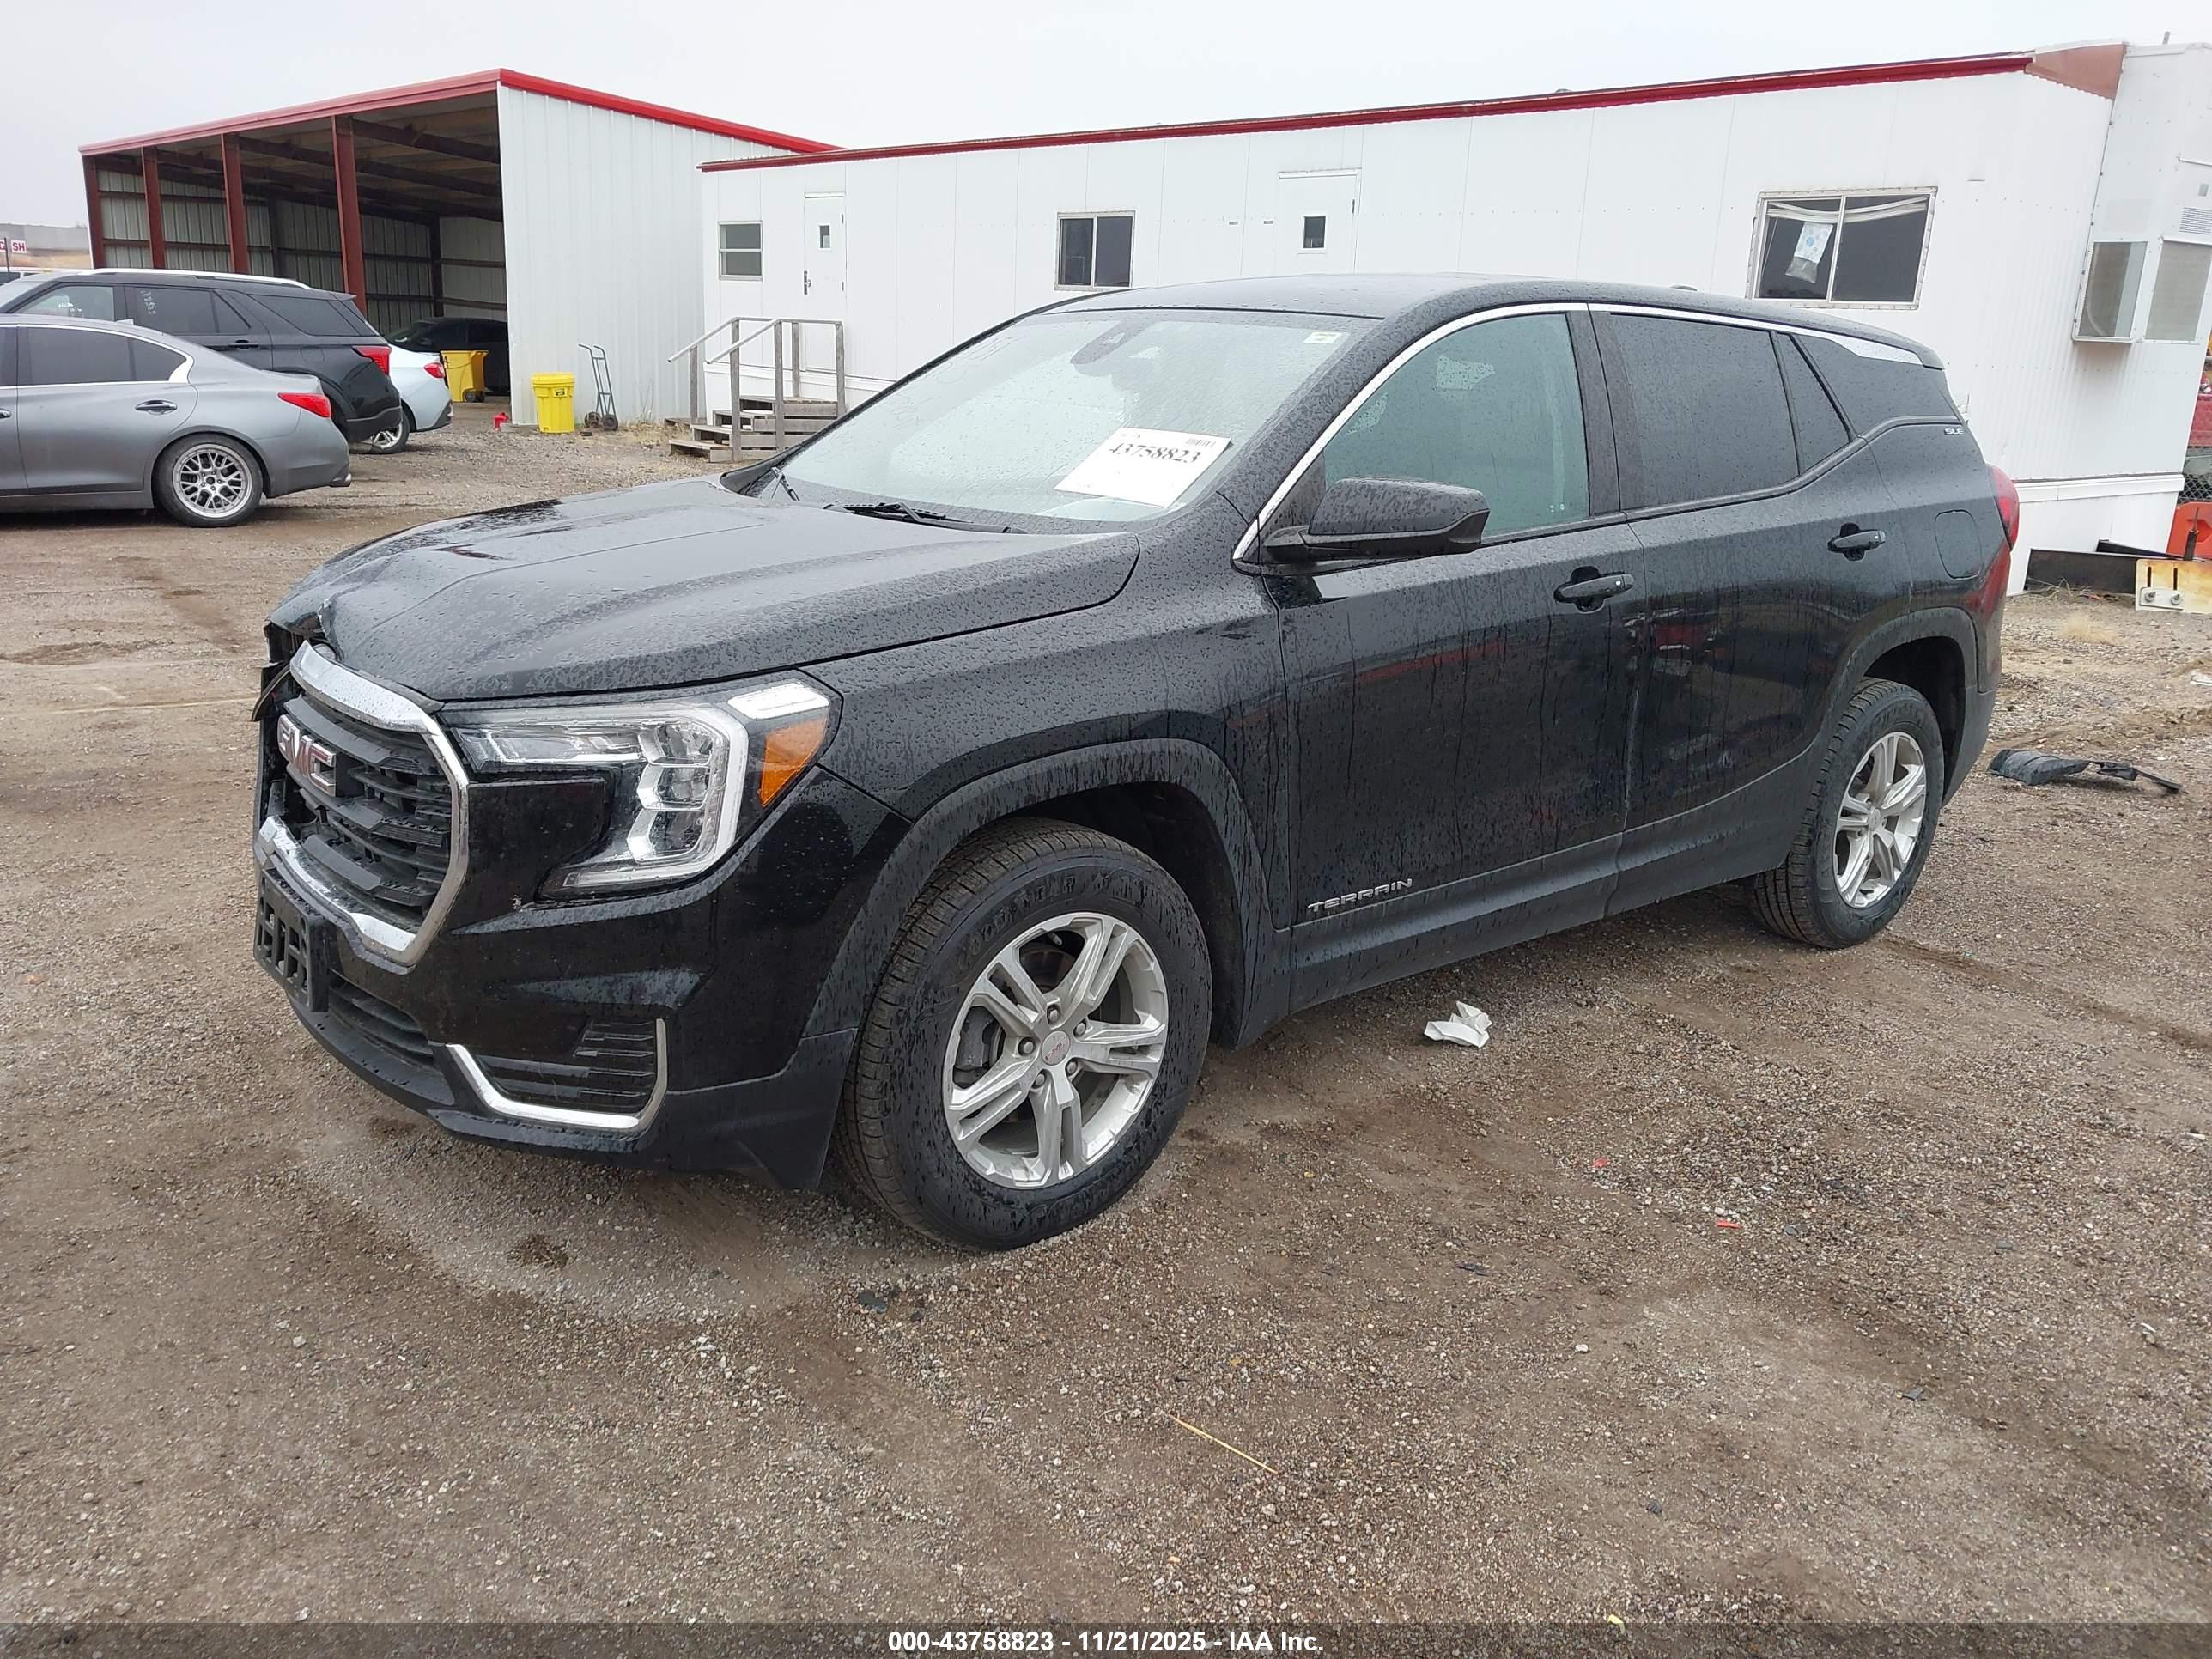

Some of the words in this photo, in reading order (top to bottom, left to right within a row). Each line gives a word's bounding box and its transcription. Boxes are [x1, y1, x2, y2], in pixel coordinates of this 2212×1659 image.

[1109, 442, 1201, 464] 43758823
[277, 714, 336, 797] GMC
[1307, 878, 1413, 912] TERRAIN
